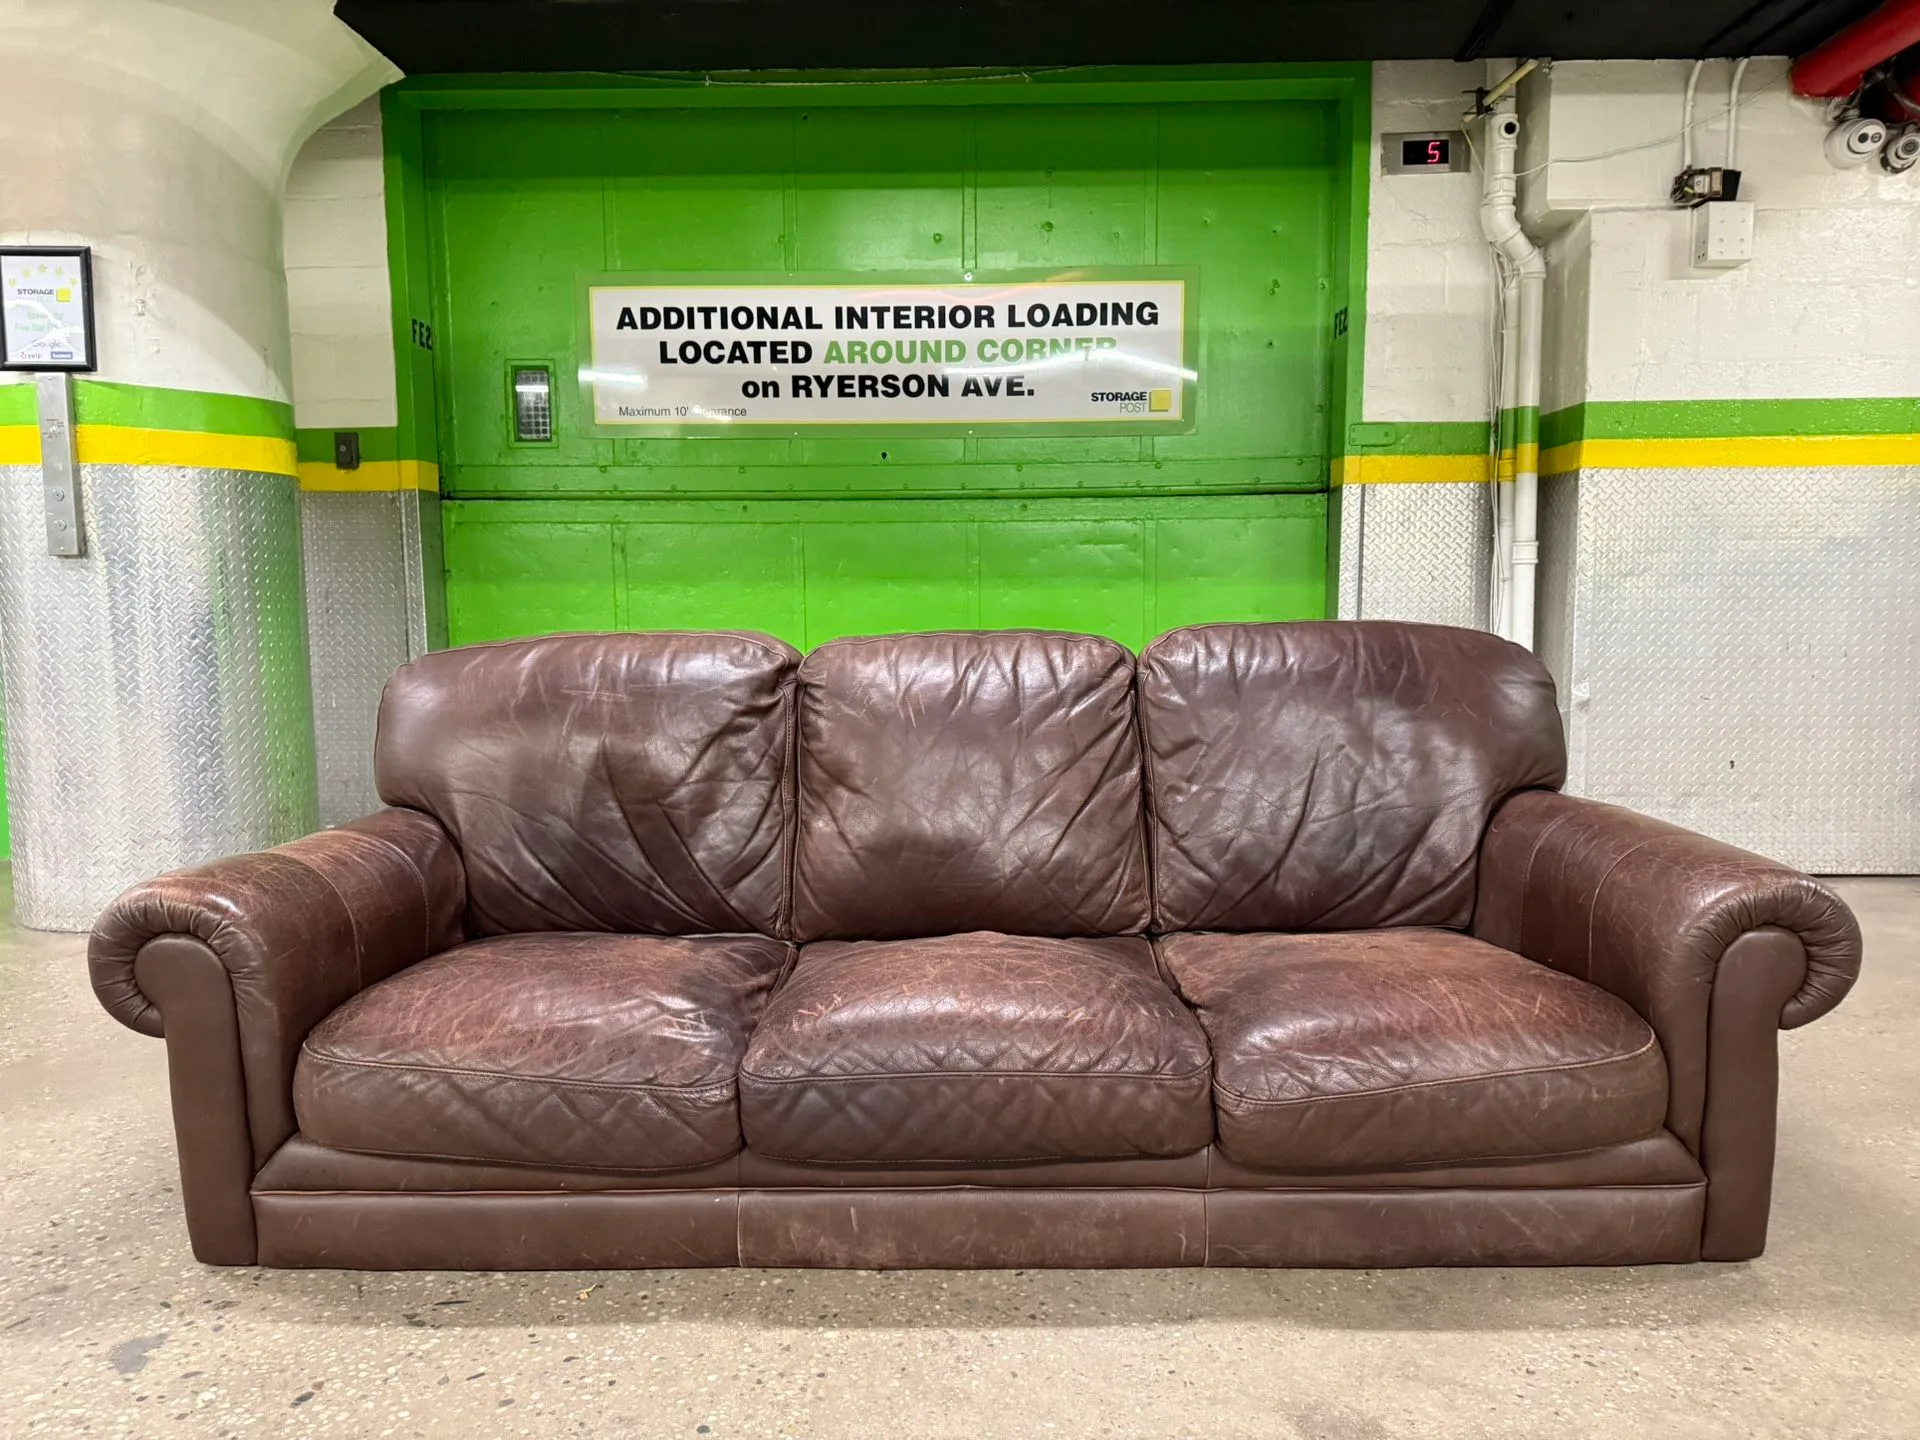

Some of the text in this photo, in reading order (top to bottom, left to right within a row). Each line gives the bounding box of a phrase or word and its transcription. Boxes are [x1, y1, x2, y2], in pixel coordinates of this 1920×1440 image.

[1426, 141, 1441, 163] 5
[17, 288, 55, 296] STORAGE
[616, 301, 1159, 330] ADDITIONAL INTERIOR LOADING
[659, 340, 813, 365] LOCATED
[824, 339, 968, 365] AROUND
[741, 373, 1035, 399] on RYERSON AVE.
[1091, 391, 1148, 402] STORAGE
[618, 406, 671, 417] Maximum
[675, 406, 689, 417] 10'
[1119, 402, 1148, 413] POST
